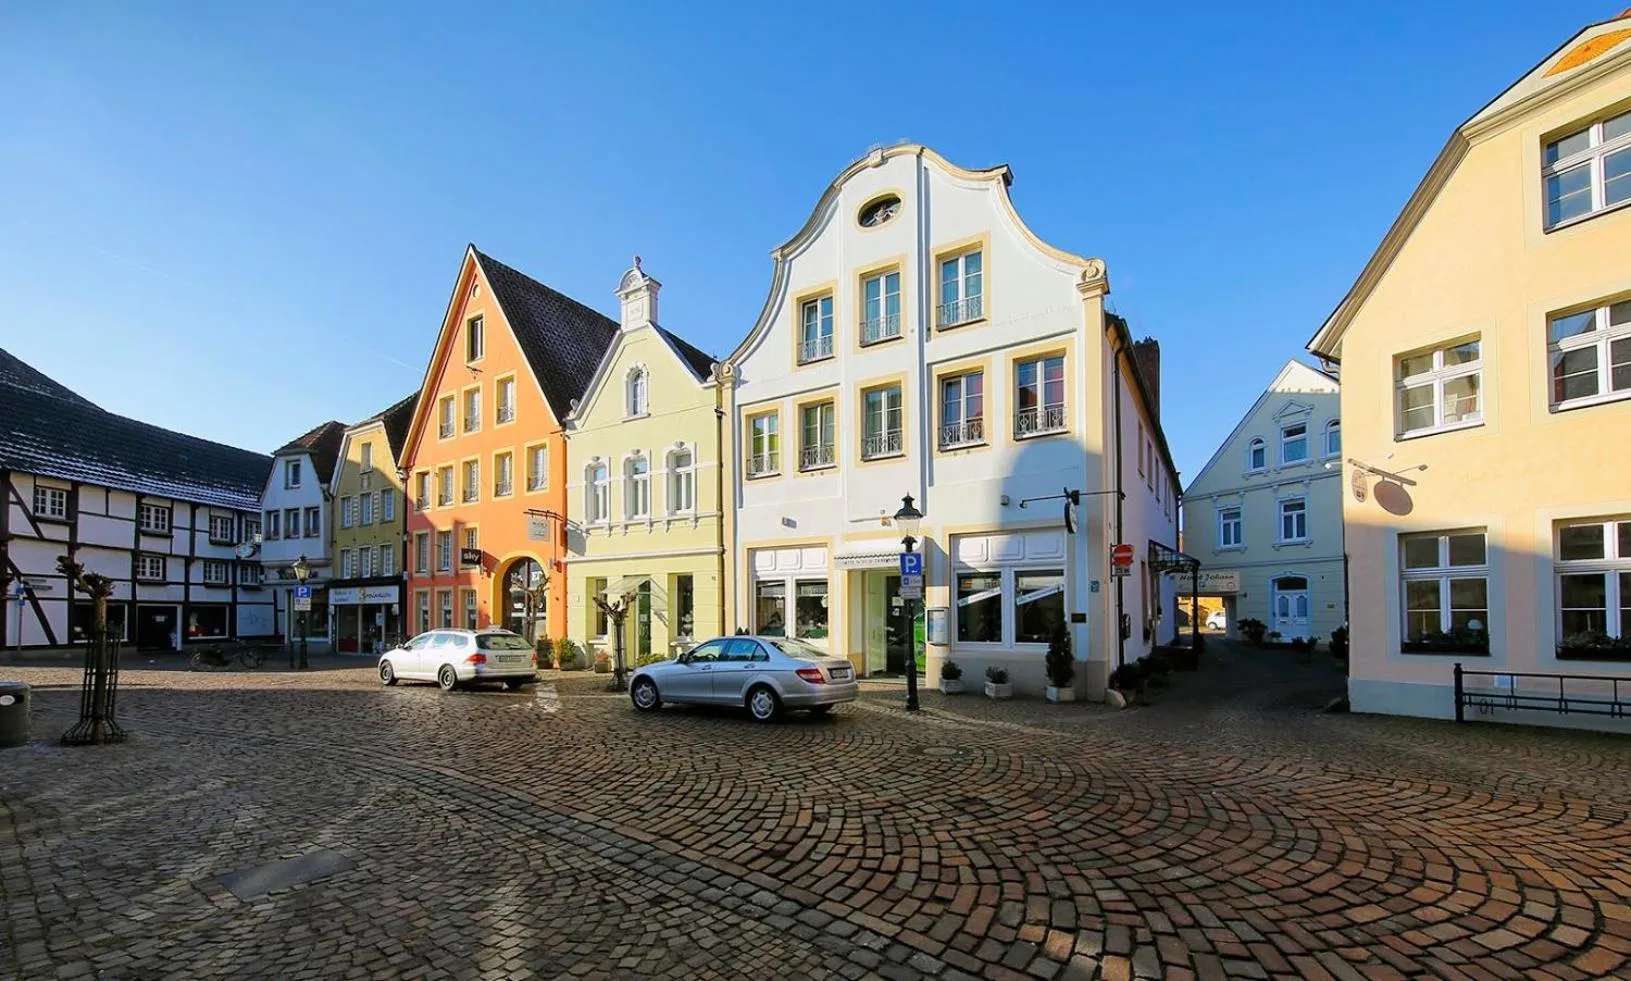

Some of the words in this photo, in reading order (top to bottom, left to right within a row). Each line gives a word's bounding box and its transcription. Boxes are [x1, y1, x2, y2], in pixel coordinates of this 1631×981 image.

[463, 551, 480, 561] sky
[905, 556, 917, 573] P
[297, 587, 308, 597] P
